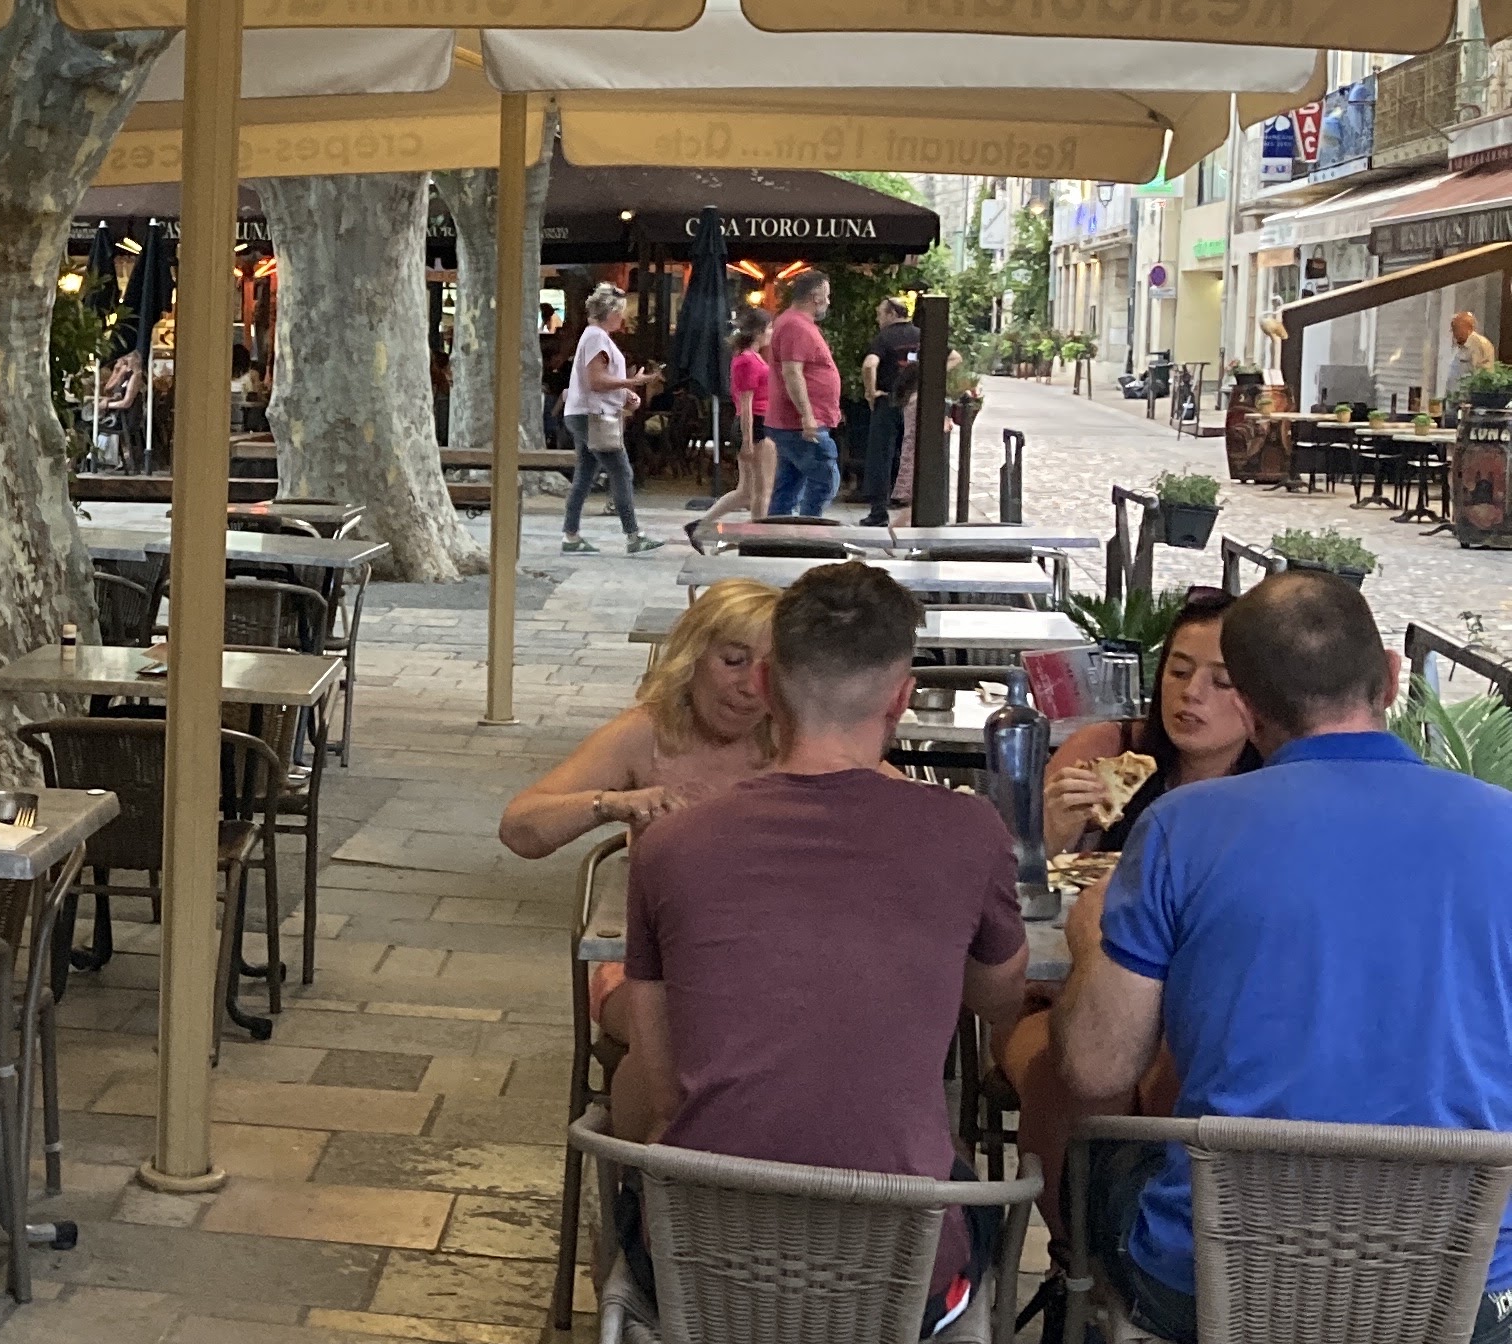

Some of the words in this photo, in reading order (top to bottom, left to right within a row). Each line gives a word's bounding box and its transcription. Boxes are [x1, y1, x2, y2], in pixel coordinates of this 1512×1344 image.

[685, 217, 740, 237] CSA
[746, 217, 810, 237] TORO
[816, 218, 877, 238] LUNA
[1469, 427, 1511, 441] LUNA
